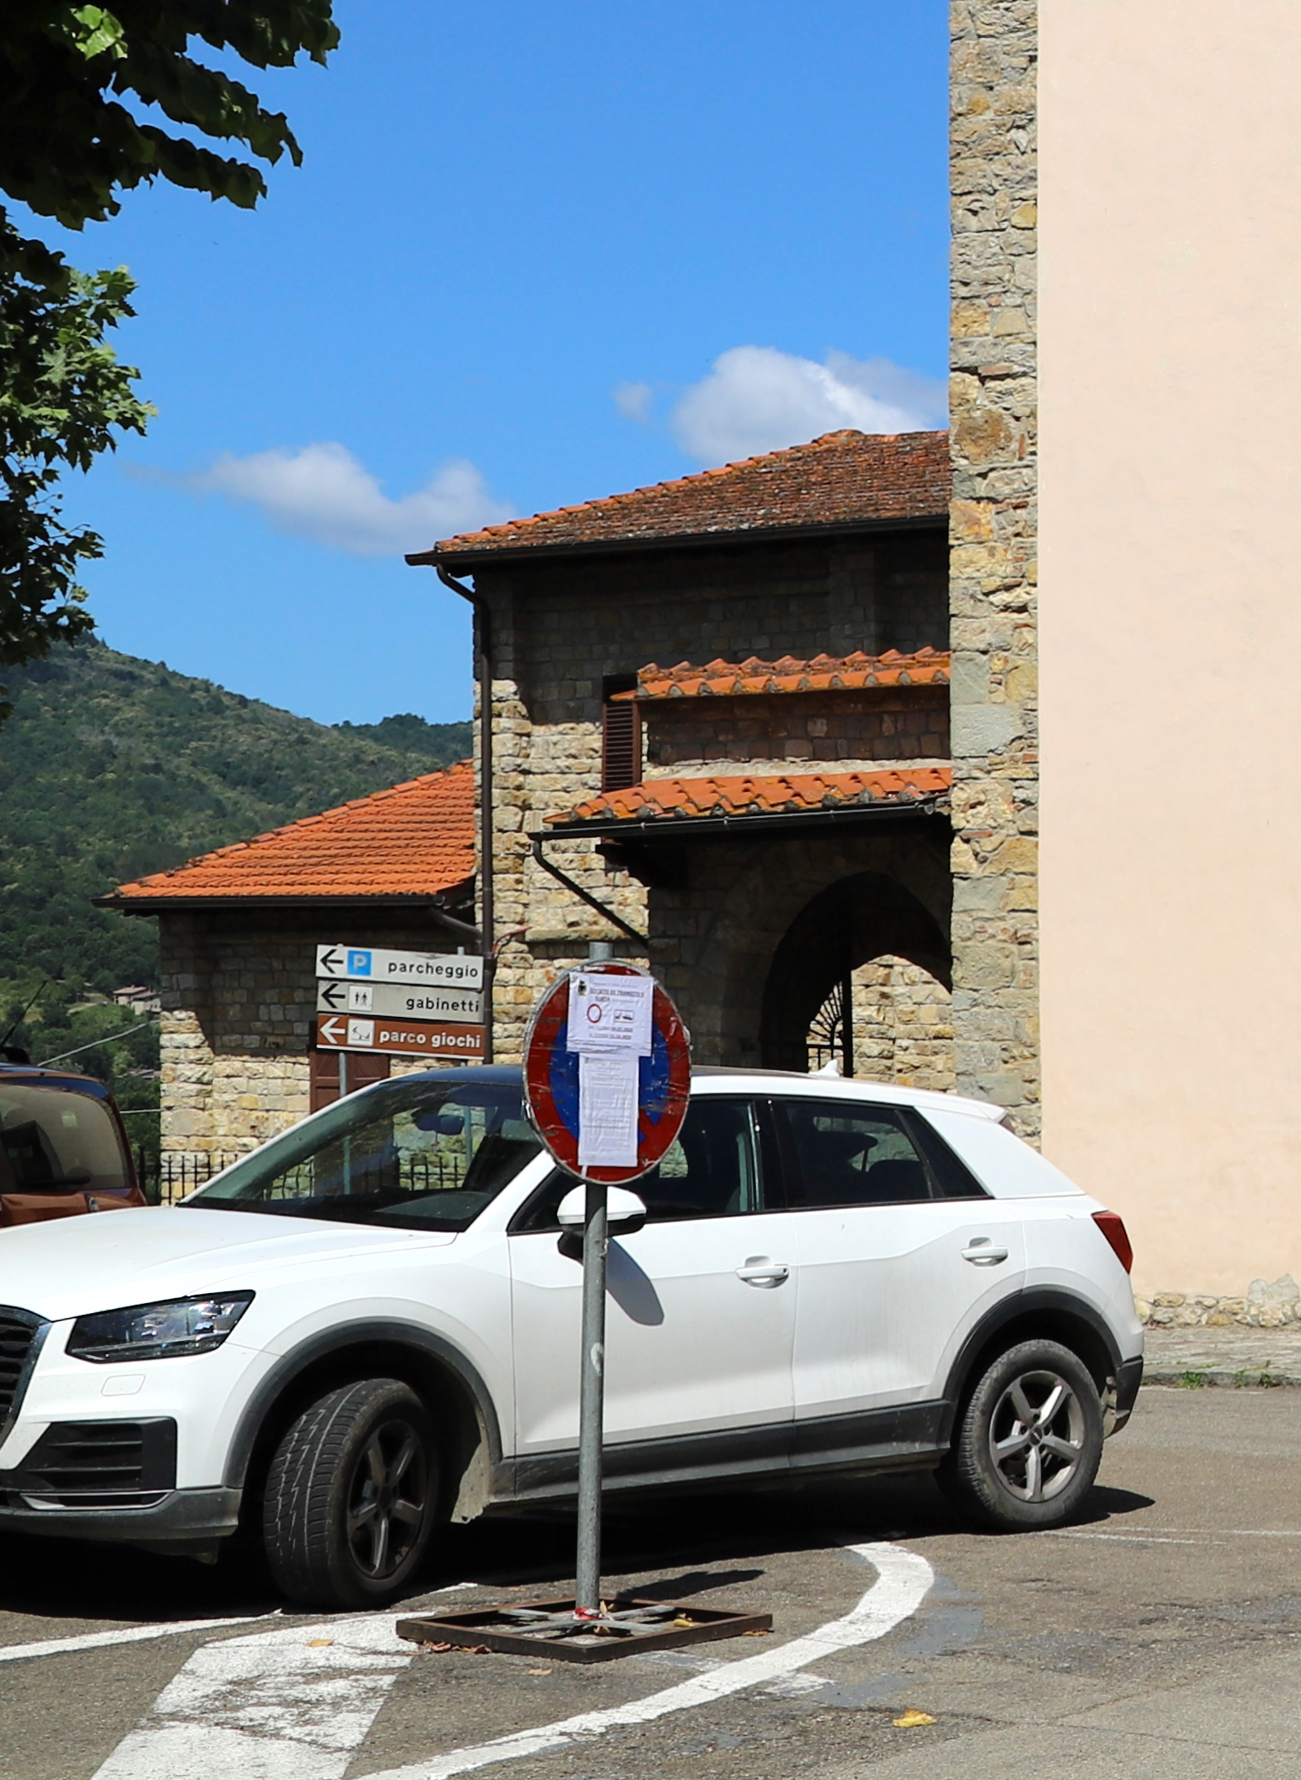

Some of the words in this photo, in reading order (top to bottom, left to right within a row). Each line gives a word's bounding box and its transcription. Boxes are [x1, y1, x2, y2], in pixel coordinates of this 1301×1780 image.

[388, 962, 479, 979] parcheggio
[405, 997, 479, 1013] gabinetti
[379, 1030, 426, 1044] parco
[431, 1032, 481, 1048] giochi
